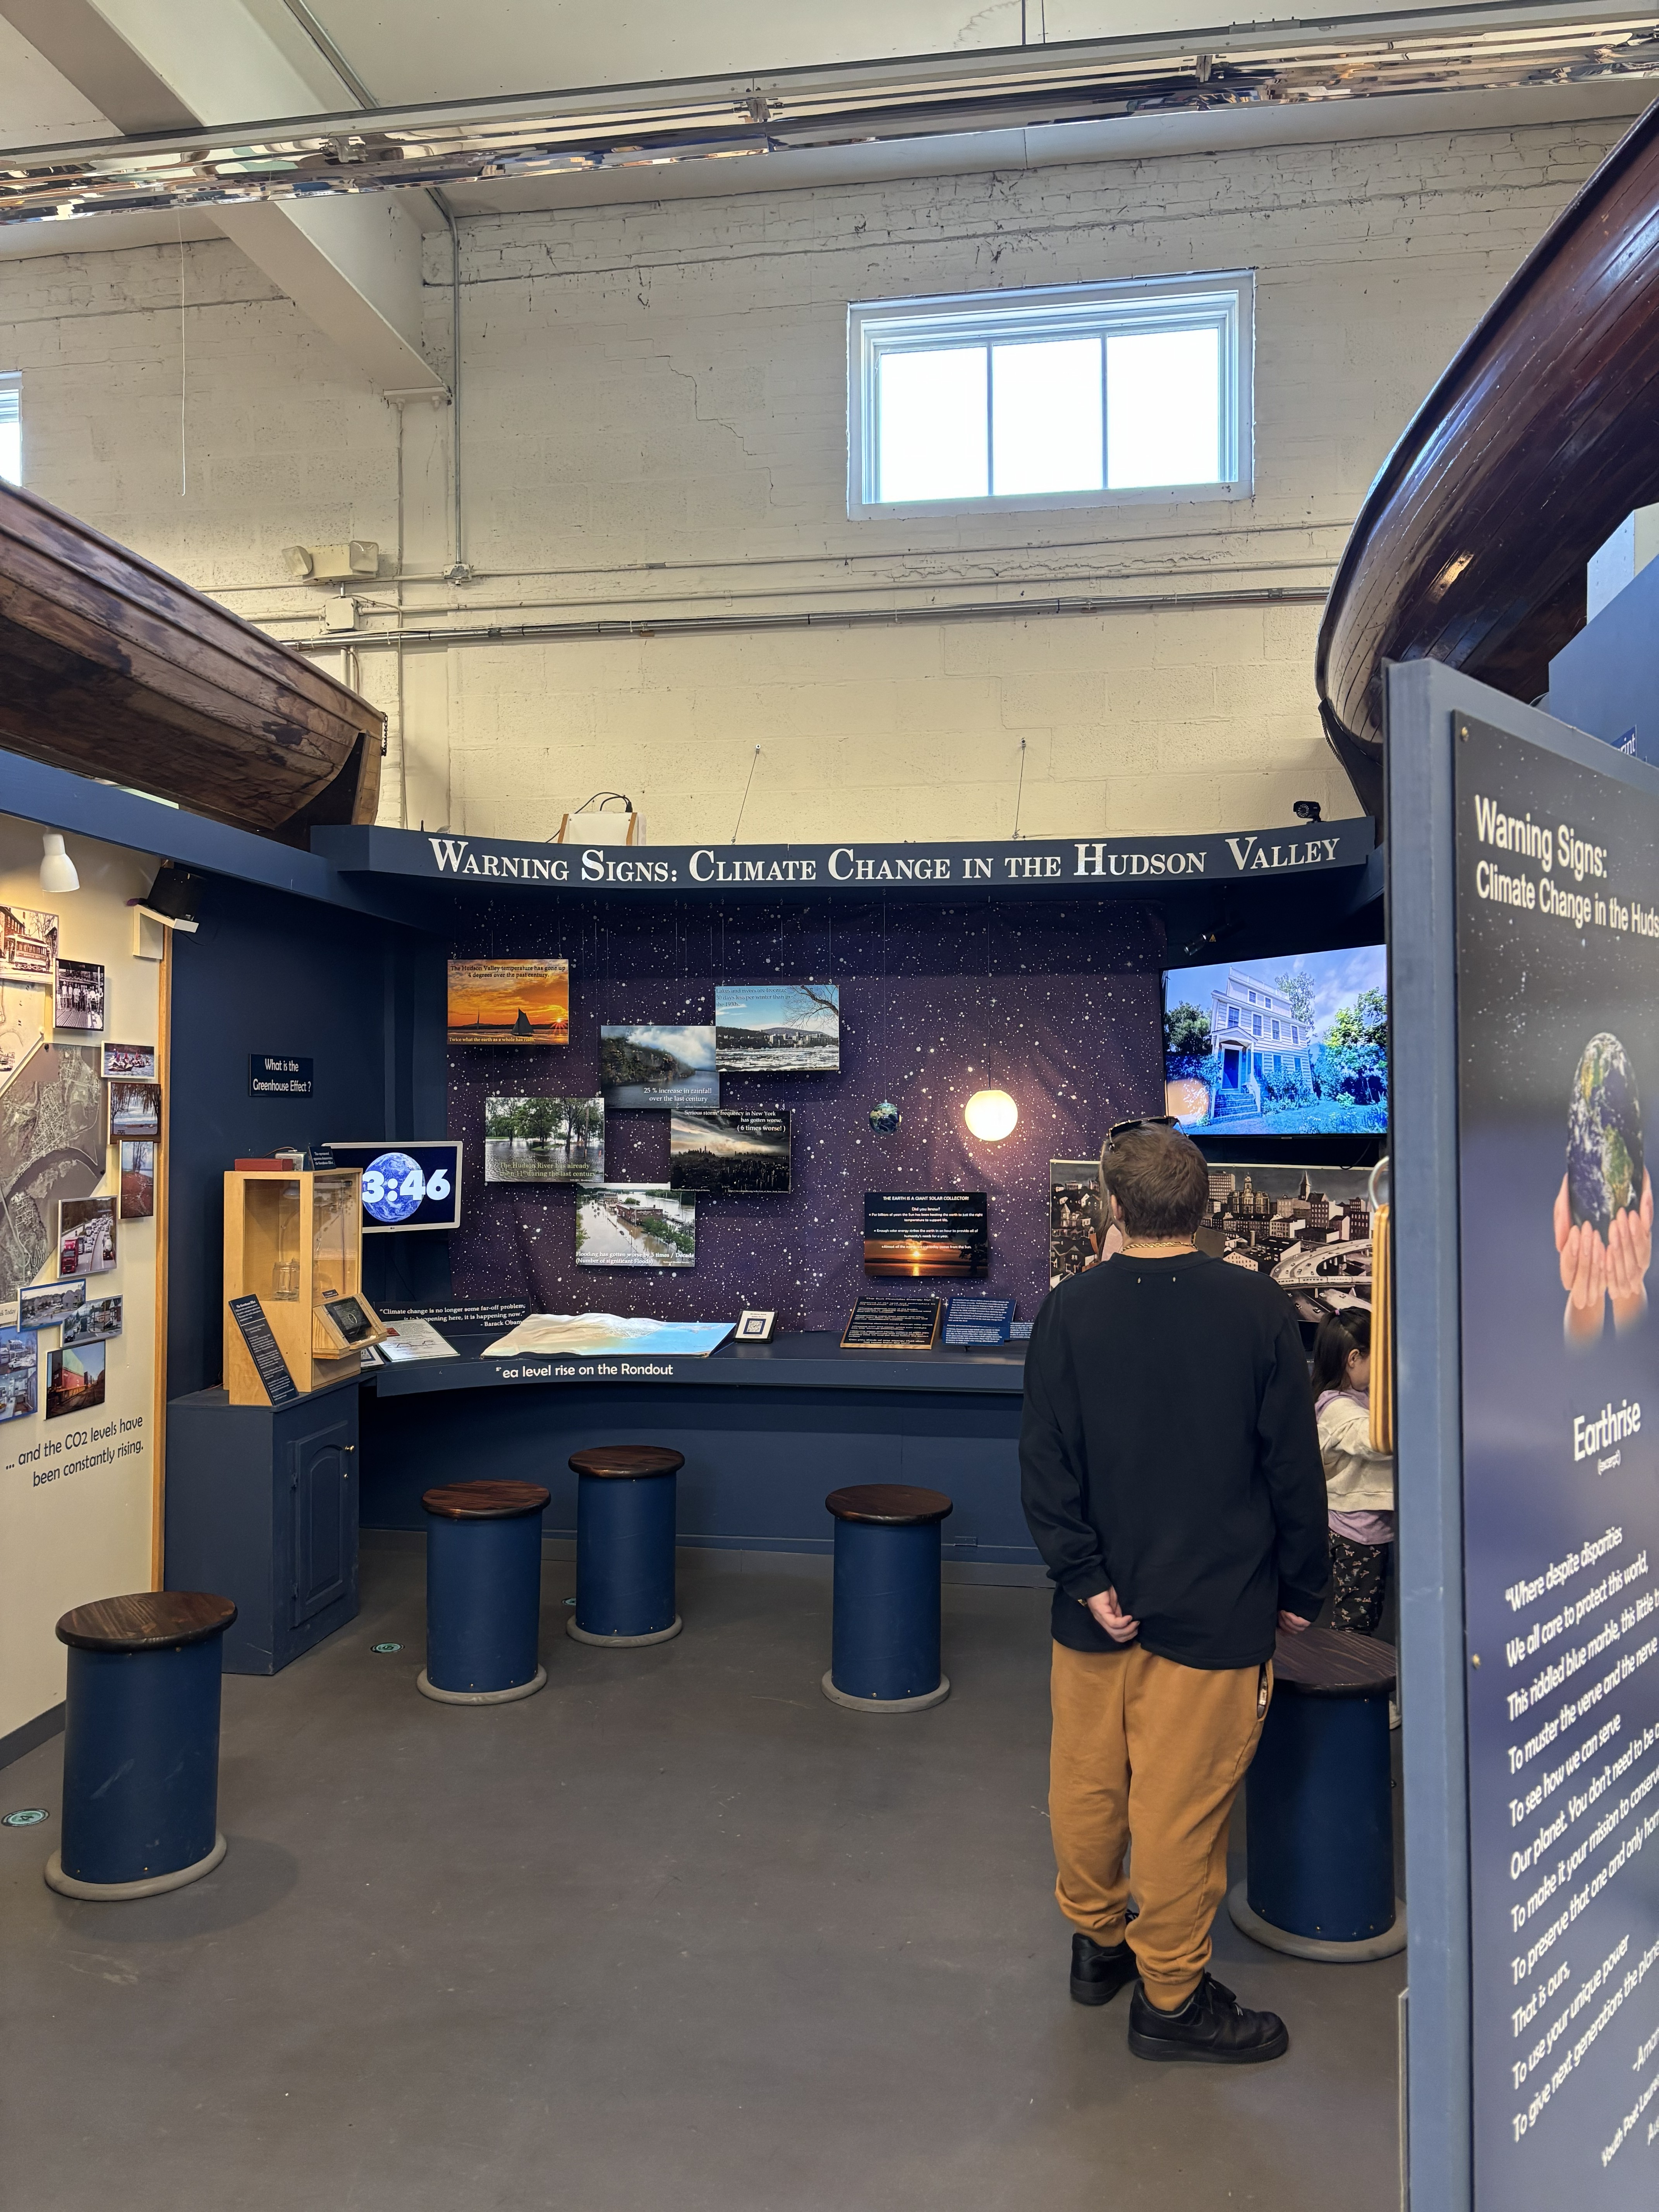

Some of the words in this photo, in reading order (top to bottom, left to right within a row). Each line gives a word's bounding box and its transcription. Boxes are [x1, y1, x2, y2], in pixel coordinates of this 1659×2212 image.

[428, 838, 569, 881] WARNING
[581, 849, 677, 882] SIGNS:
[689, 850, 815, 881] CLIMATE
[828, 848, 950, 880] CHANGE
[963, 858, 993, 879] IN
[1005, 856, 1061, 878] THE
[1073, 843, 1207, 876] HUDSON
[1225, 836, 1340, 871] VALLEY
[1475, 794, 1553, 872] Warning
[1557, 824, 1607, 881] Signs:
[1476, 860, 1535, 909] Climate
[1539, 878, 1591, 929] Change
[1595, 892, 1606, 926] in
[1609, 898, 1628, 931] the
[253, 1078, 289, 1091] Greenhouse
[290, 1080, 307, 1092] Effect
[308, 1081, 311, 1092] ?
[265, 1058, 282, 1071] What
[283, 1060, 287, 1071] is
[289, 1060, 299, 1072] the
[362, 1169, 451, 1204] 3:46
[523, 1365, 551, 1377] level
[555, 1365, 575, 1376] rise
[579, 1367, 594, 1375] on
[597, 1364, 618, 1375] the
[621, 1363, 673, 1375] Rondout
[18, 1444, 40, 1465] and
[44, 1440, 62, 1457] the
[65, 1432, 87, 1450] CO2
[91, 1421, 117, 1443] levels
[119, 1417, 143, 1433] have
[1574, 1399, 1641, 1461] Earthrise
[33, 1468, 60, 1487] been
[63, 1447, 115, 1476] constantly
[117, 1440, 144, 1458] rising.
[1505, 1576, 1544, 1612] "Where
[1546, 1553, 1579, 1589] despite
[1581, 1526, 1622, 1567] disparities
[1506, 1637, 1525, 1668] We
[1527, 1623, 1540, 1654] all
[1542, 1614, 1563, 1644] care
[1564, 1606, 1575, 1628] to
[1576, 1579, 1607, 1625] protect
[1608, 1570, 1623, 1596] this
[1624, 1550, 1648, 1585] world,
[1509, 1799, 1524, 1827] To
[1526, 1785, 1542, 1815] see
[1543, 1764, 1564, 1798] how
[1566, 1750, 1580, 1776] we
[1582, 1735, 1598, 1762] can
[1599, 1714, 1621, 1747] serve
[1512, 1994, 1537, 2037] That
[1538, 1985, 1546, 2009] is
[1547, 1961, 1570, 1997] ours,
[1512, 2061, 1527, 2090] To
[1528, 2039, 1546, 2071] use
[1547, 2009, 1569, 2054] your
[1570, 1969, 1601, 2019] unique
[1602, 1935, 1629, 1984] power
